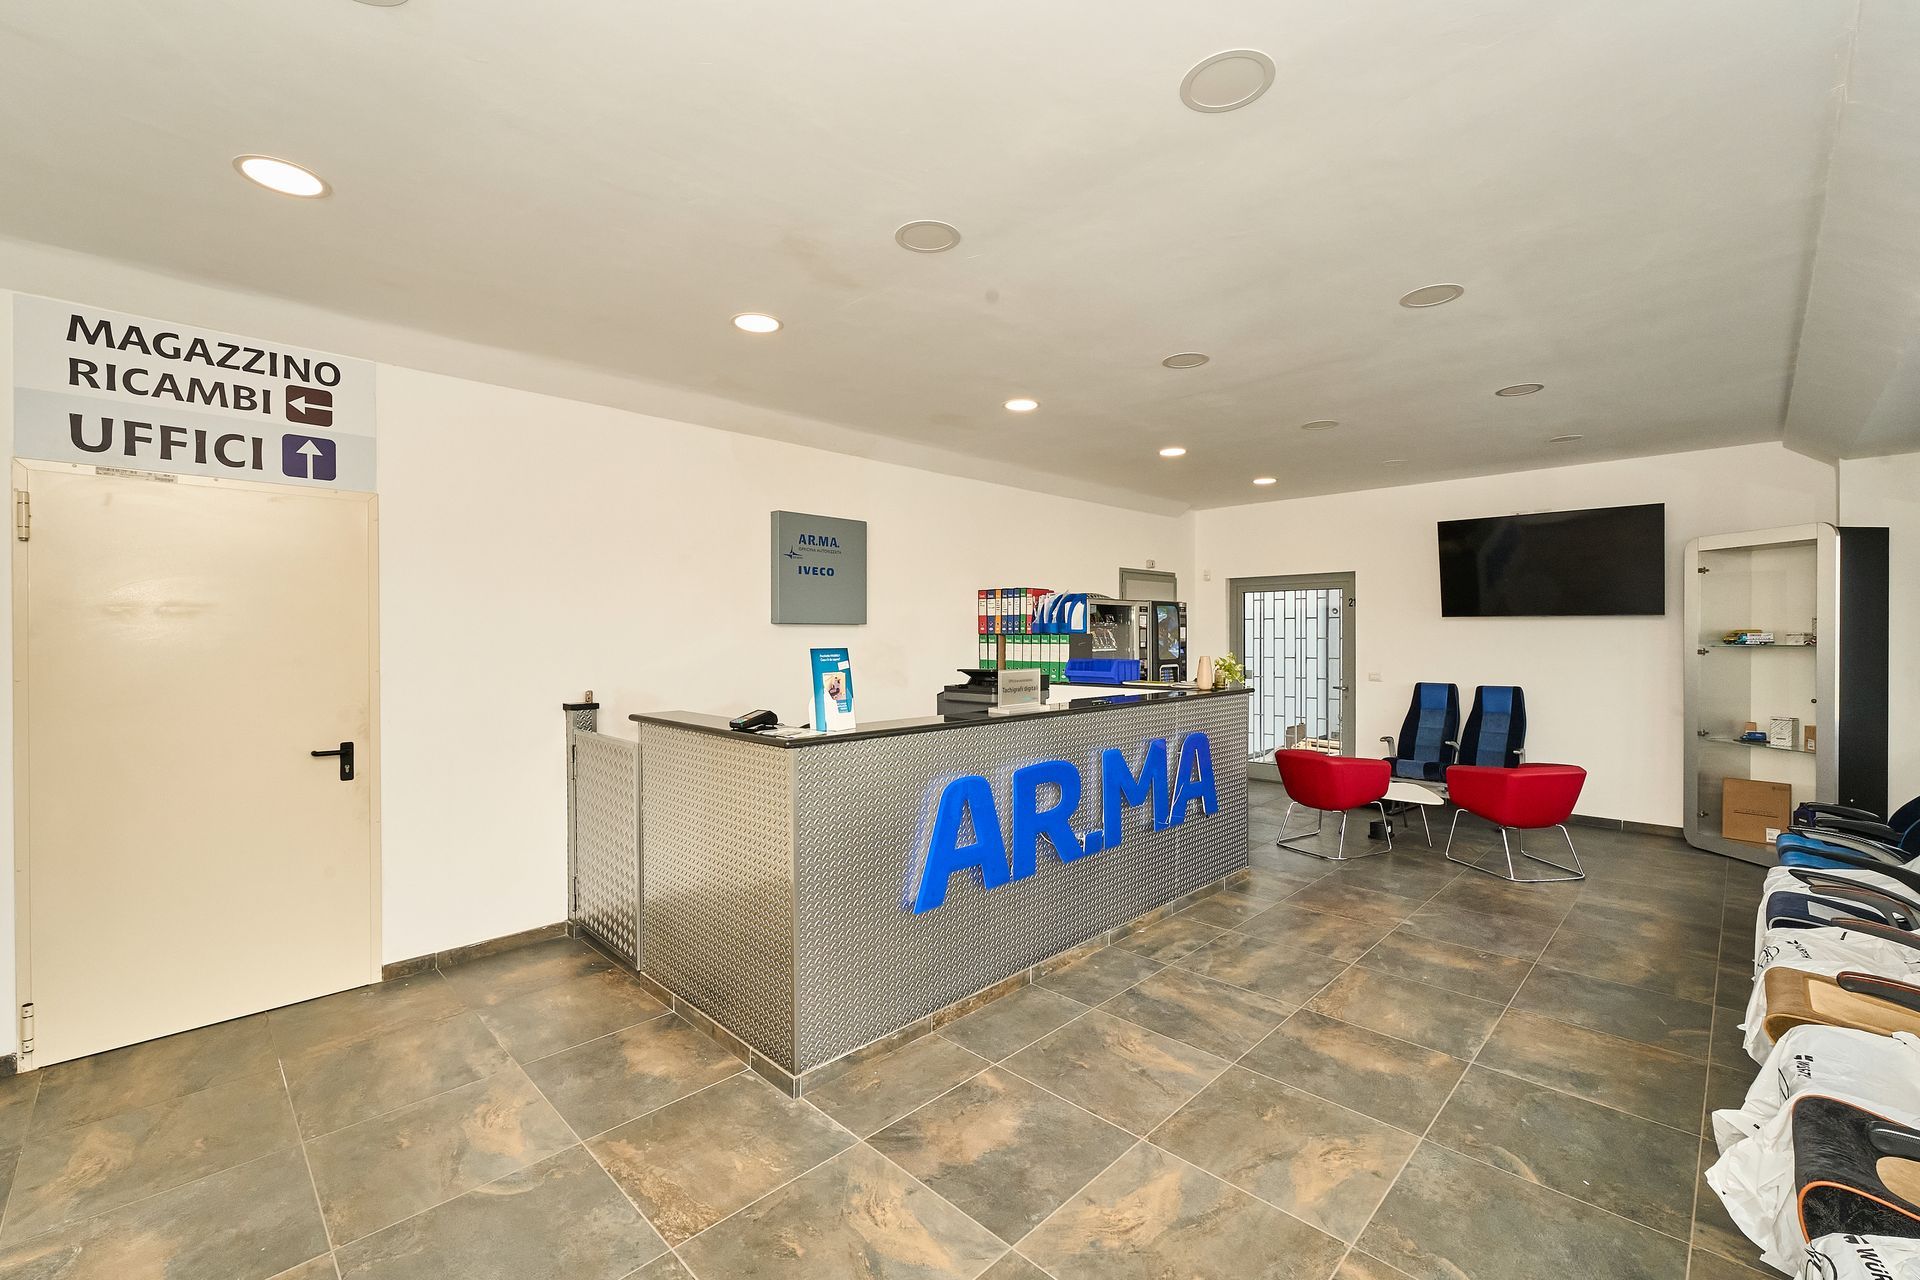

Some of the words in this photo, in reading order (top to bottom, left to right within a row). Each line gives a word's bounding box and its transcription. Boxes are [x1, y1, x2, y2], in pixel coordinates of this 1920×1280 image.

[66, 314, 341, 387] MAGAZZINO
[68, 357, 271, 415] RICAMBI
[68, 413, 263, 470] UFFICI
[798, 533, 840, 548] AR.MA.
[798, 565, 835, 577] IVECO
